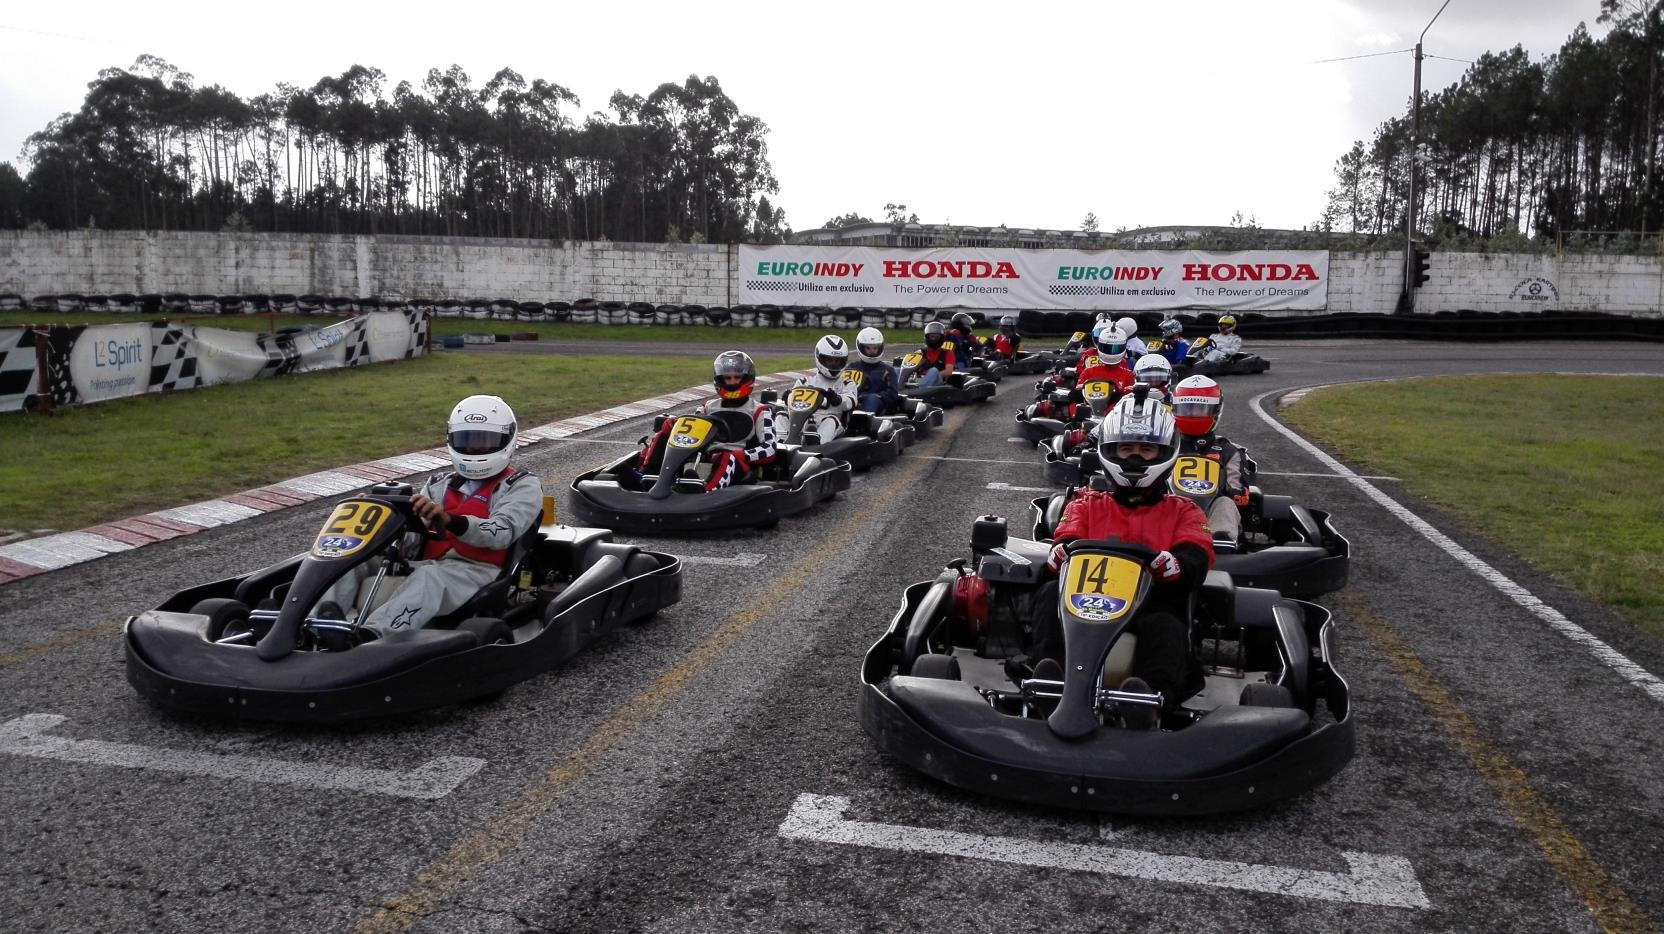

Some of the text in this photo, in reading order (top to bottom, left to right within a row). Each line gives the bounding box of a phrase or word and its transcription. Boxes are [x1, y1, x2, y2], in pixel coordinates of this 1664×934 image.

[757, 261, 864, 277] EUROINDY
[882, 260, 1020, 279] HONDA
[1057, 266, 1164, 281] EUROINDY
[1182, 263, 1320, 281] HONDA
[798, 282, 875, 293] Utiliza em exclusivo
[893, 284, 1009, 294] The Power of Dreams
[1100, 286, 1125, 296] Utiliza
[1141, 286, 1176, 296] exclusivo
[1195, 286, 1309, 297] The Power of Dreams
[108, 337, 142, 371] Spirit
[1092, 382, 1102, 392] 6
[793, 389, 815, 402] 27
[678, 417, 696, 434] 5
[1180, 458, 1210, 481] 21
[325, 503, 384, 536] 29
[324, 538, 343, 547] 24
[1076, 557, 1109, 594] 14
[1083, 597, 1105, 609] 24
